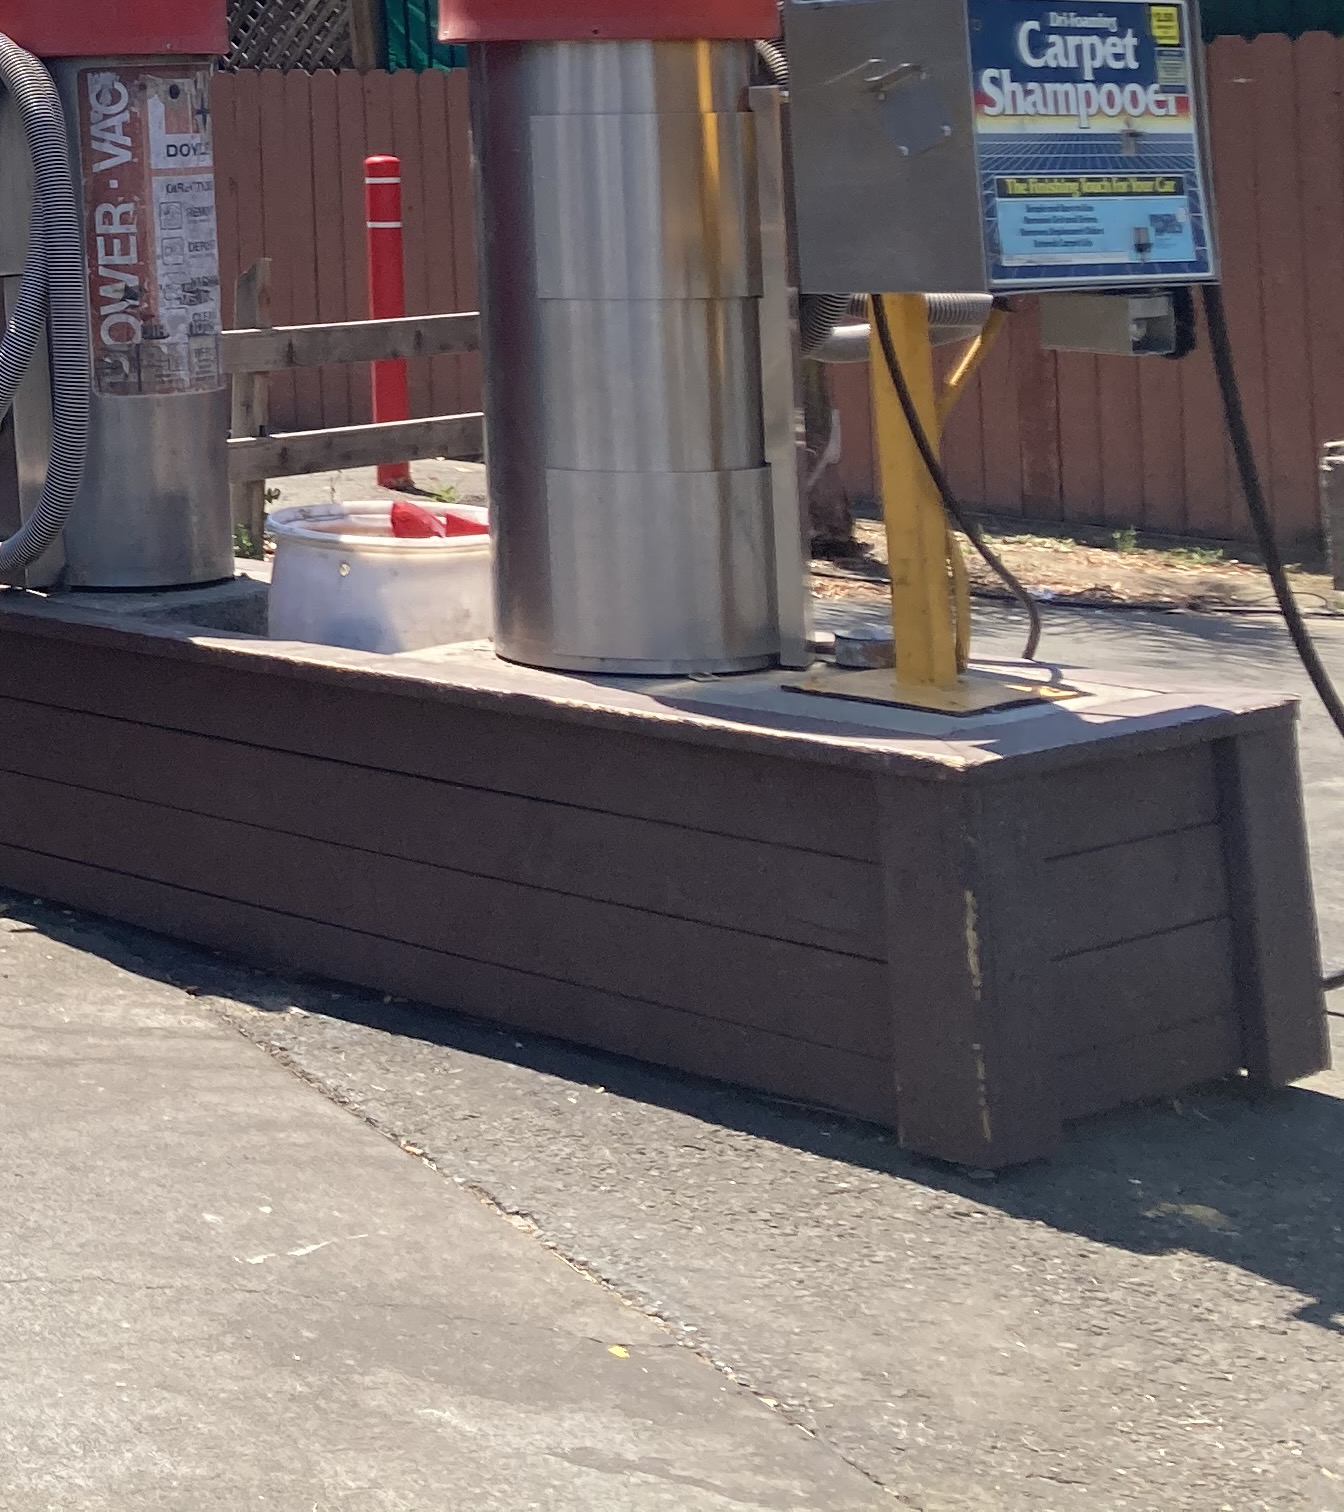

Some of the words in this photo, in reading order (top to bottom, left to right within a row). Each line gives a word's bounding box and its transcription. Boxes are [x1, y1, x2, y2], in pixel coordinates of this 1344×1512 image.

[1018, 20, 1140, 81] Carpet
[90, 80, 132, 173] VAC
[981, 68, 1178, 128] Shampooer
